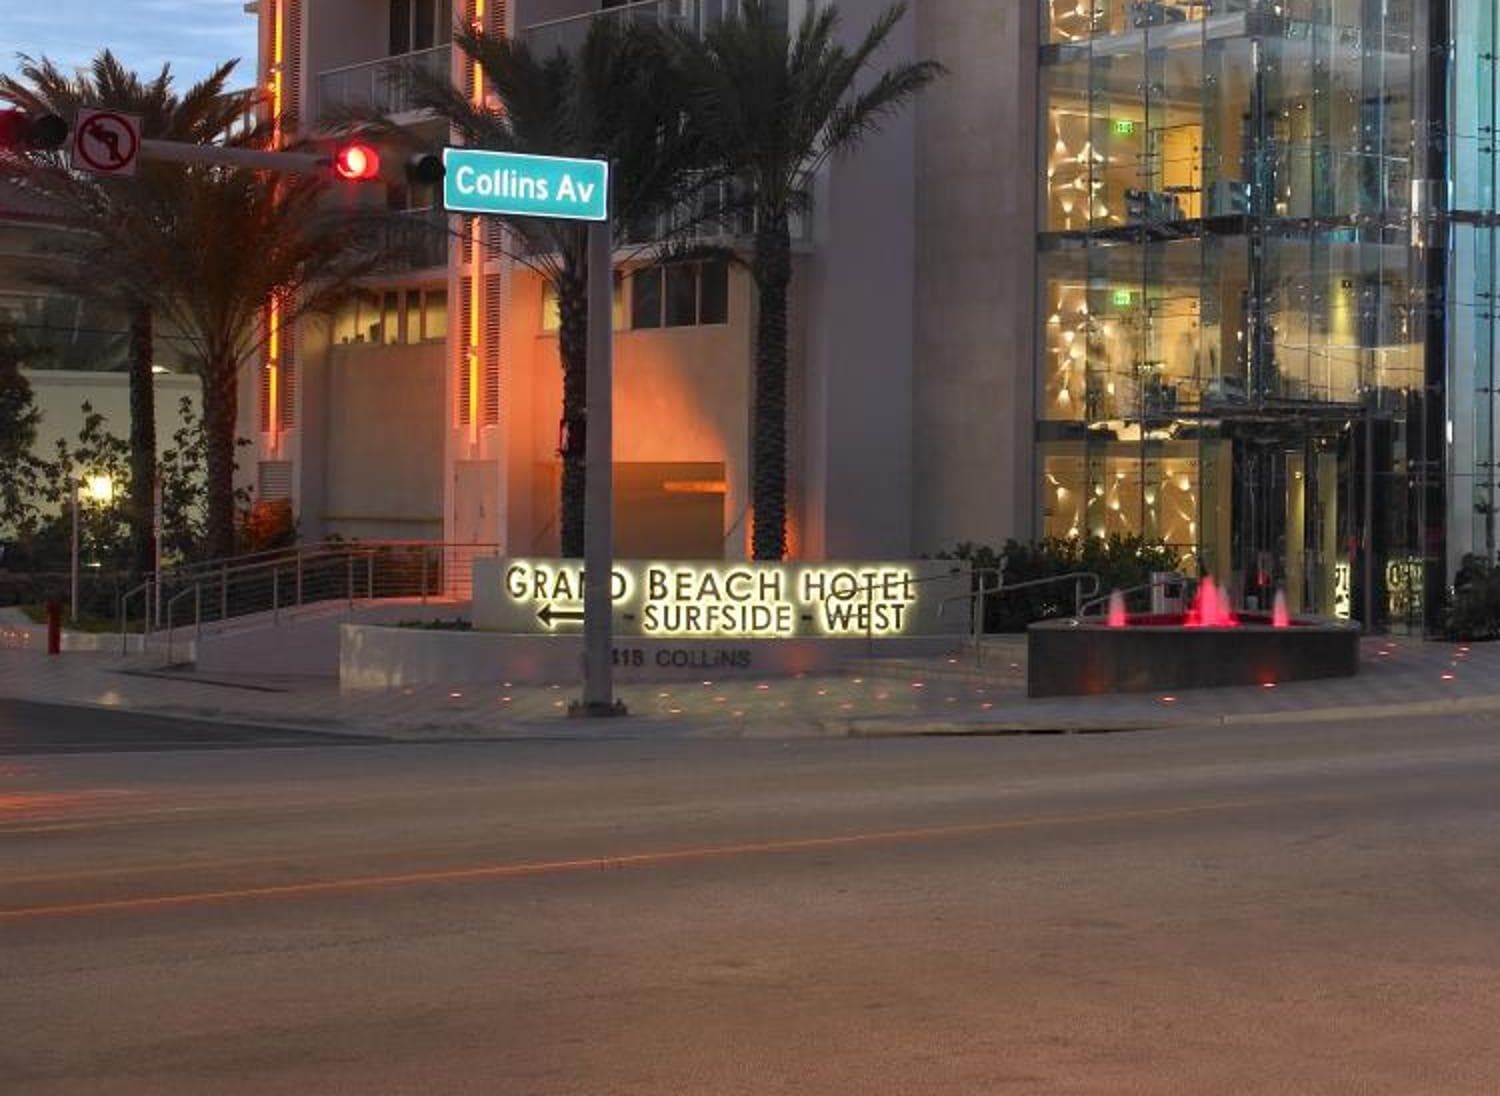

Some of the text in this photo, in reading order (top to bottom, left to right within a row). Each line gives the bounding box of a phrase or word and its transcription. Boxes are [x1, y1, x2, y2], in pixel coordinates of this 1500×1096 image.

[455, 165, 595, 203] Collins Av
[506, 566, 915, 601] GRAD BEACH HOTEL
[643, 604, 790, 631] SURFSIDE
[826, 603, 905, 630] WEST
[656, 648, 752, 667] COLLINS
